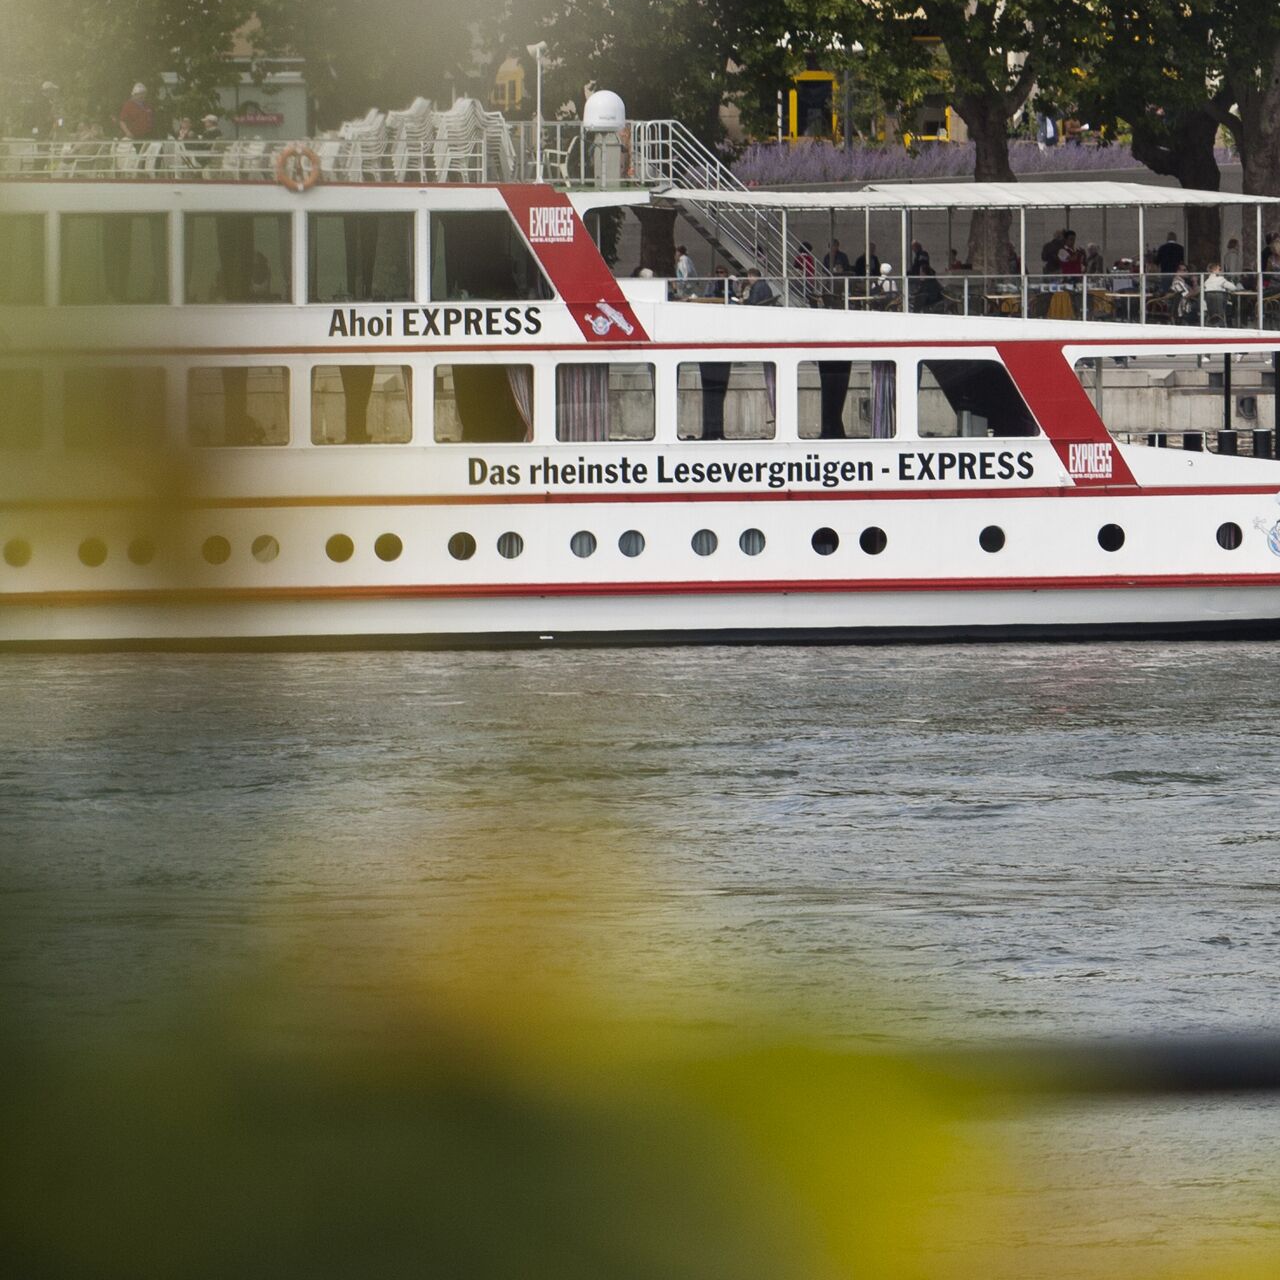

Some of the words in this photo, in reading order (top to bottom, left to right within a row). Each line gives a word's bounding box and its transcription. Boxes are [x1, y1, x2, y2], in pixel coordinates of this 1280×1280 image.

[529, 207, 574, 237] EXPRESS
[328, 308, 392, 337] Ahoi
[402, 306, 542, 336] EXPRESS
[468, 456, 521, 486] Das
[529, 456, 648, 485] rheinste
[657, 454, 874, 489] Lesevergnügen
[898, 451, 1034, 481] EXPRESS
[1069, 443, 1113, 473] EXPRESS
